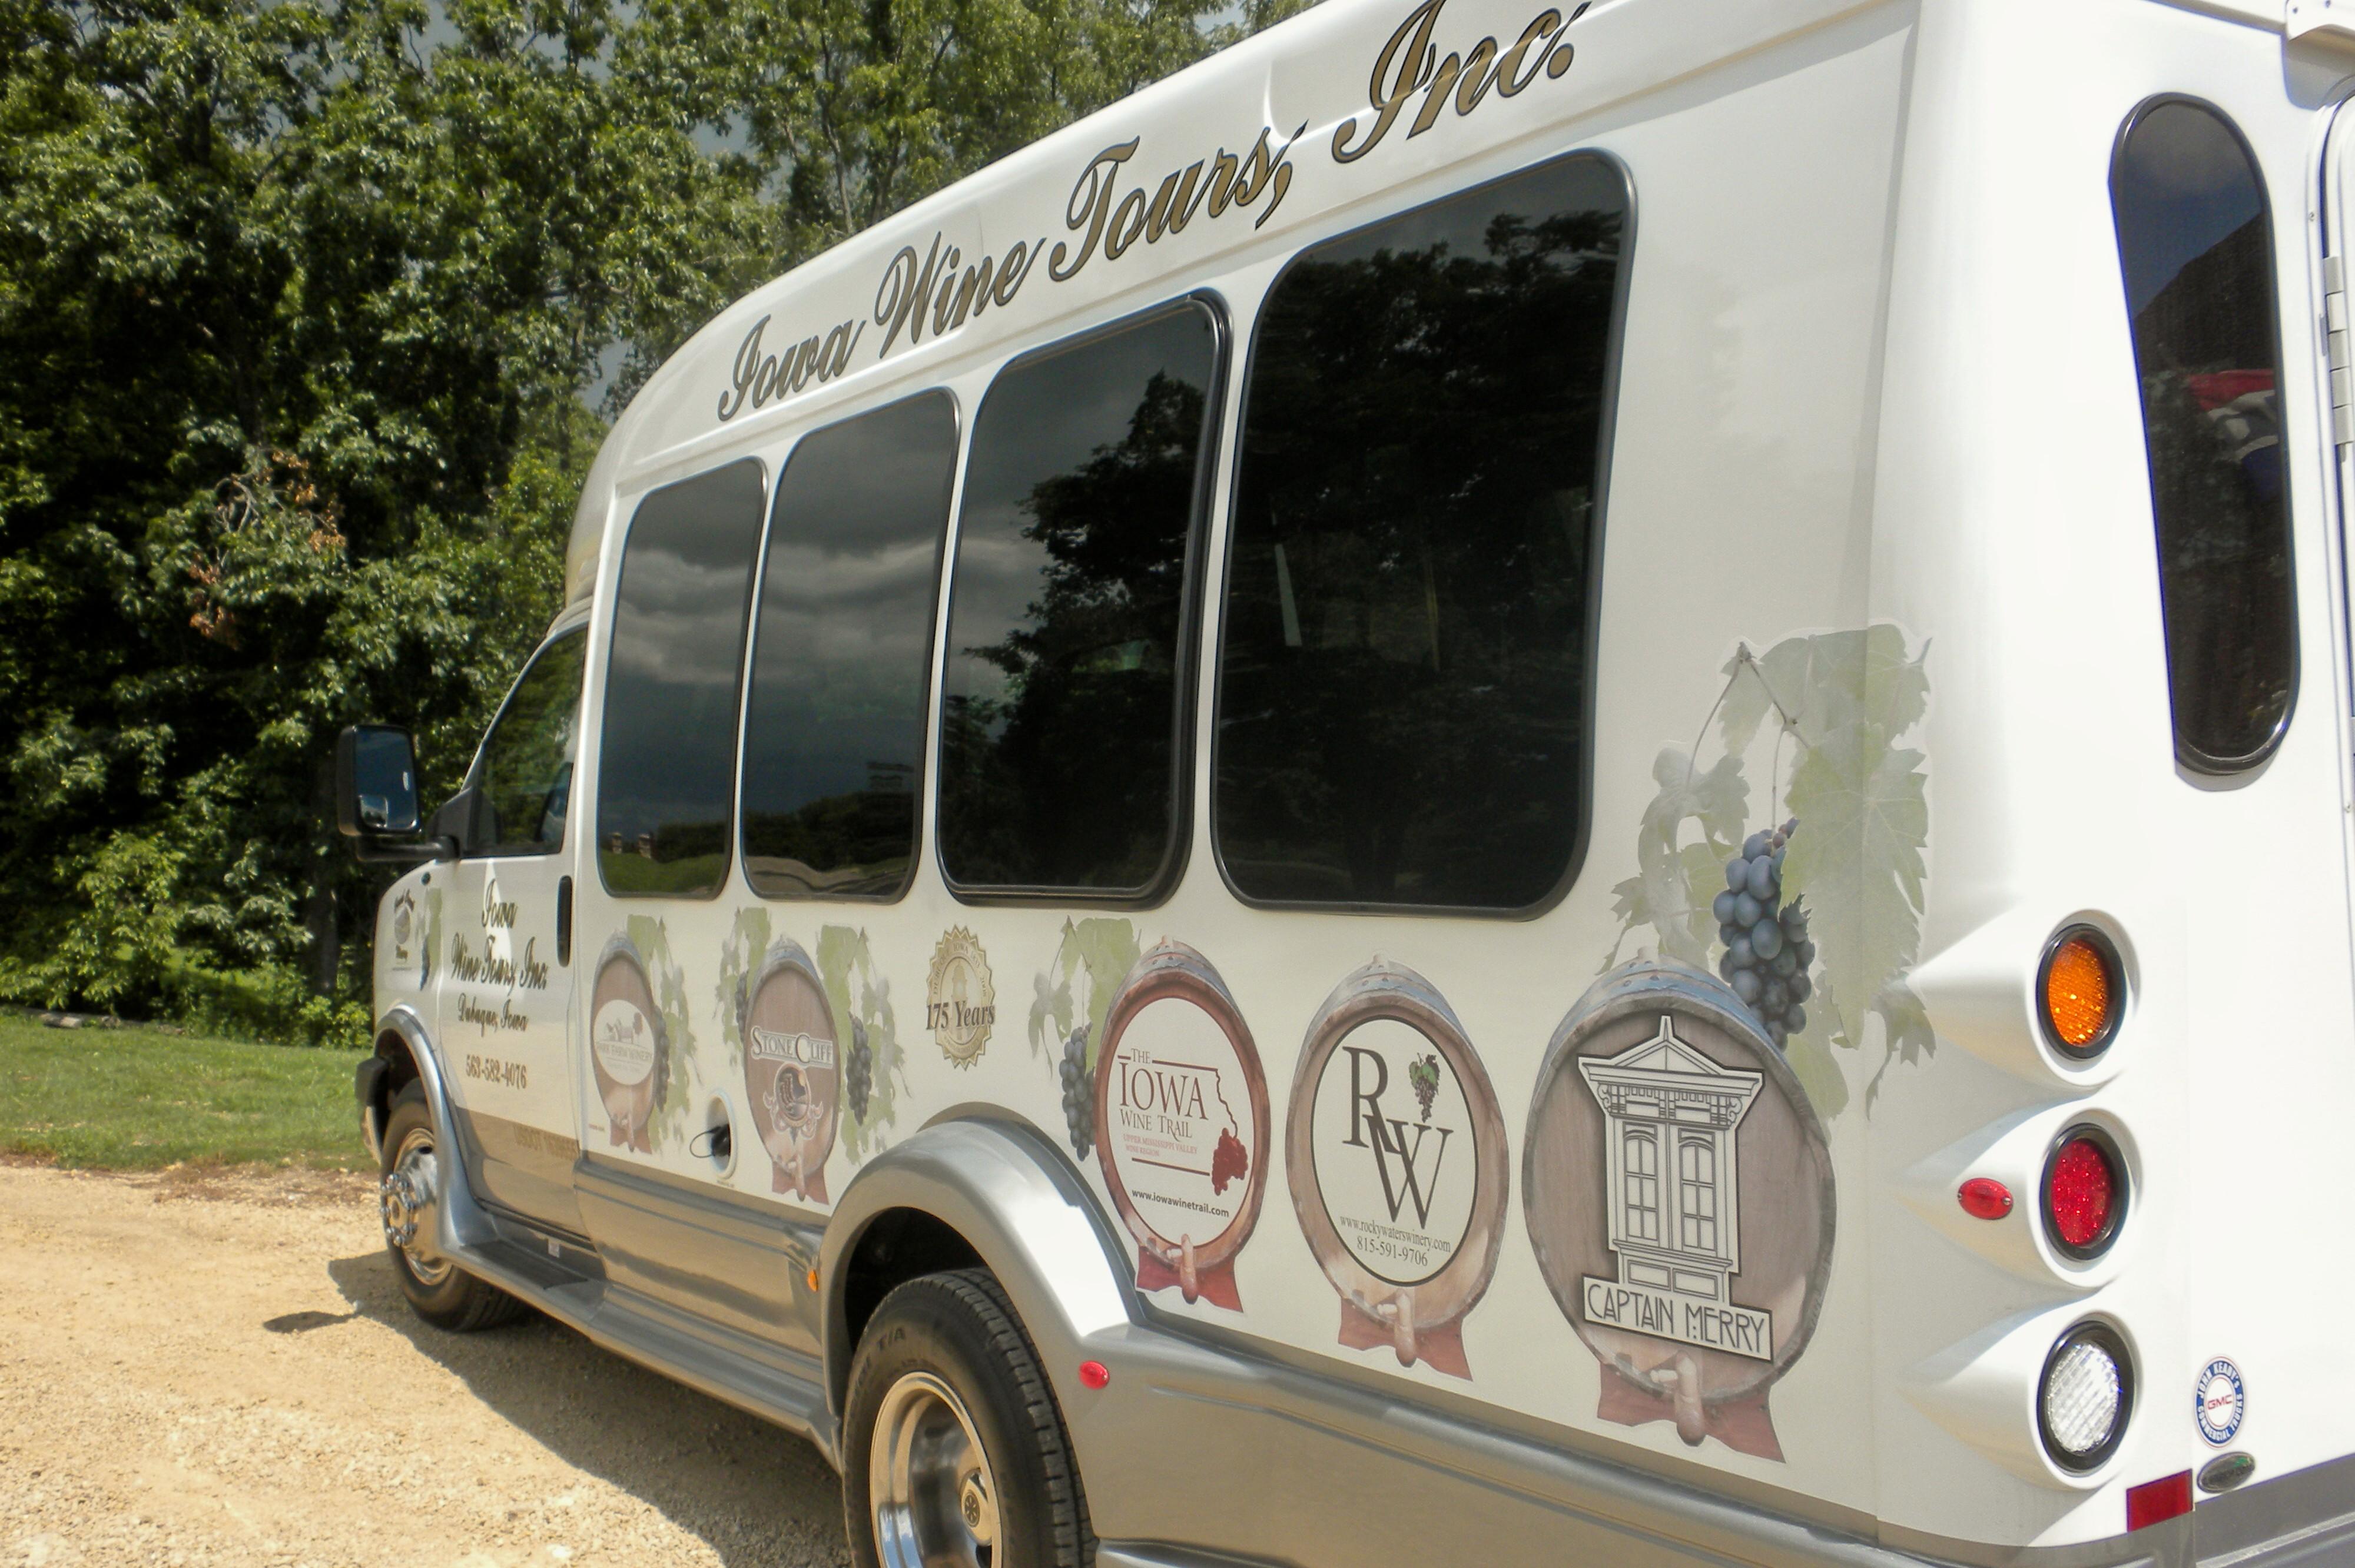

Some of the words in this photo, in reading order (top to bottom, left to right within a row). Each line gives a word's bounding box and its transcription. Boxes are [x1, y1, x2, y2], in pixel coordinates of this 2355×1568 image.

[718, 315, 865, 422] Iowa
[874, 231, 1046, 359] Wine
[1048, 121, 1308, 282] Tours,
[1331, 0, 1590, 164] Inc.
[482, 878, 518, 928] Iowa
[500, 999, 528, 1031] Iowa
[926, 1002, 949, 1031] 175
[954, 1001, 995, 1028] Years
[1131, 1048, 1150, 1064] THE
[1119, 1062, 1209, 1121] IOWA
[1119, 1109, 1152, 1131] WINE
[1157, 1115, 1192, 1142] TRAIL
[1132, 1189, 1229, 1218] www.iowawinetrail.com
[1339, 1215, 1451, 1253] www.rockywaterswinery.com
[1356, 1235, 1428, 1267] 815-591-9706
[1587, 1284, 1674, 1334] CAPTAIN
[1685, 1303, 1765, 1353] MERRY
[2208, 1394, 2233, 1410] GMC
[2198, 1406, 2231, 1441] COMMERCIAL
